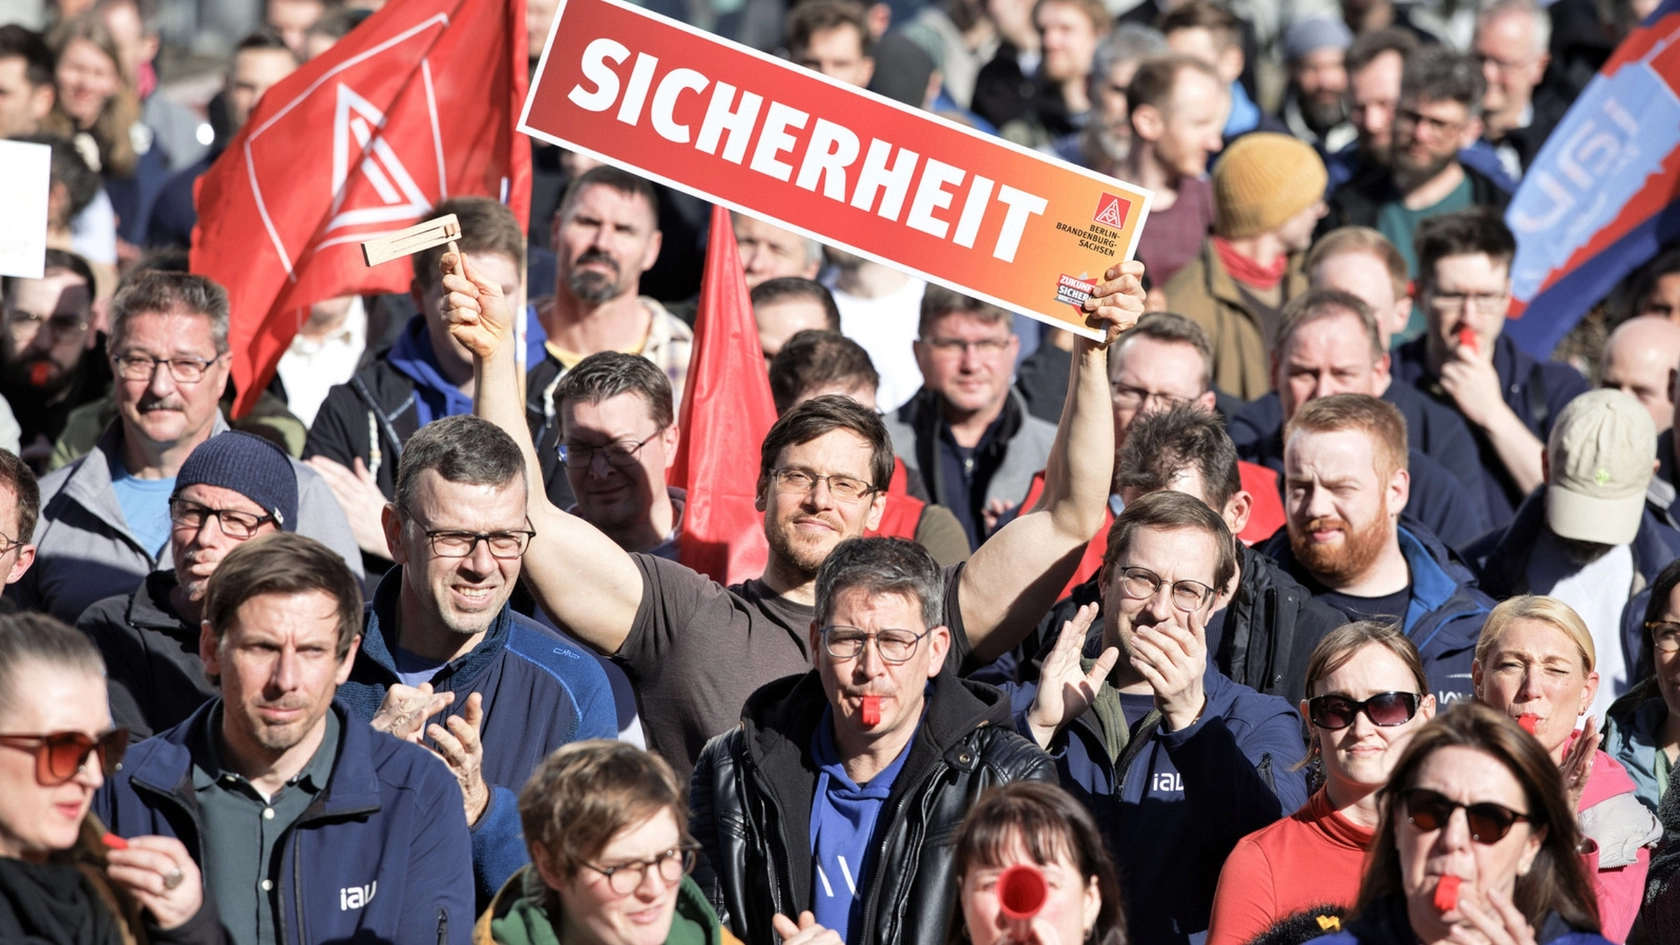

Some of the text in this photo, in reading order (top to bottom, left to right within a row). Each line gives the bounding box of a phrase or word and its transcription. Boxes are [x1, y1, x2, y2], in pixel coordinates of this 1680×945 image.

[567, 38, 1049, 263] SICHERHEIT
[1056, 222, 1117, 248] BRANDENBURG-
[1089, 224, 1120, 240] BERLIN-
[1078, 240, 1115, 257] SACHSEN
